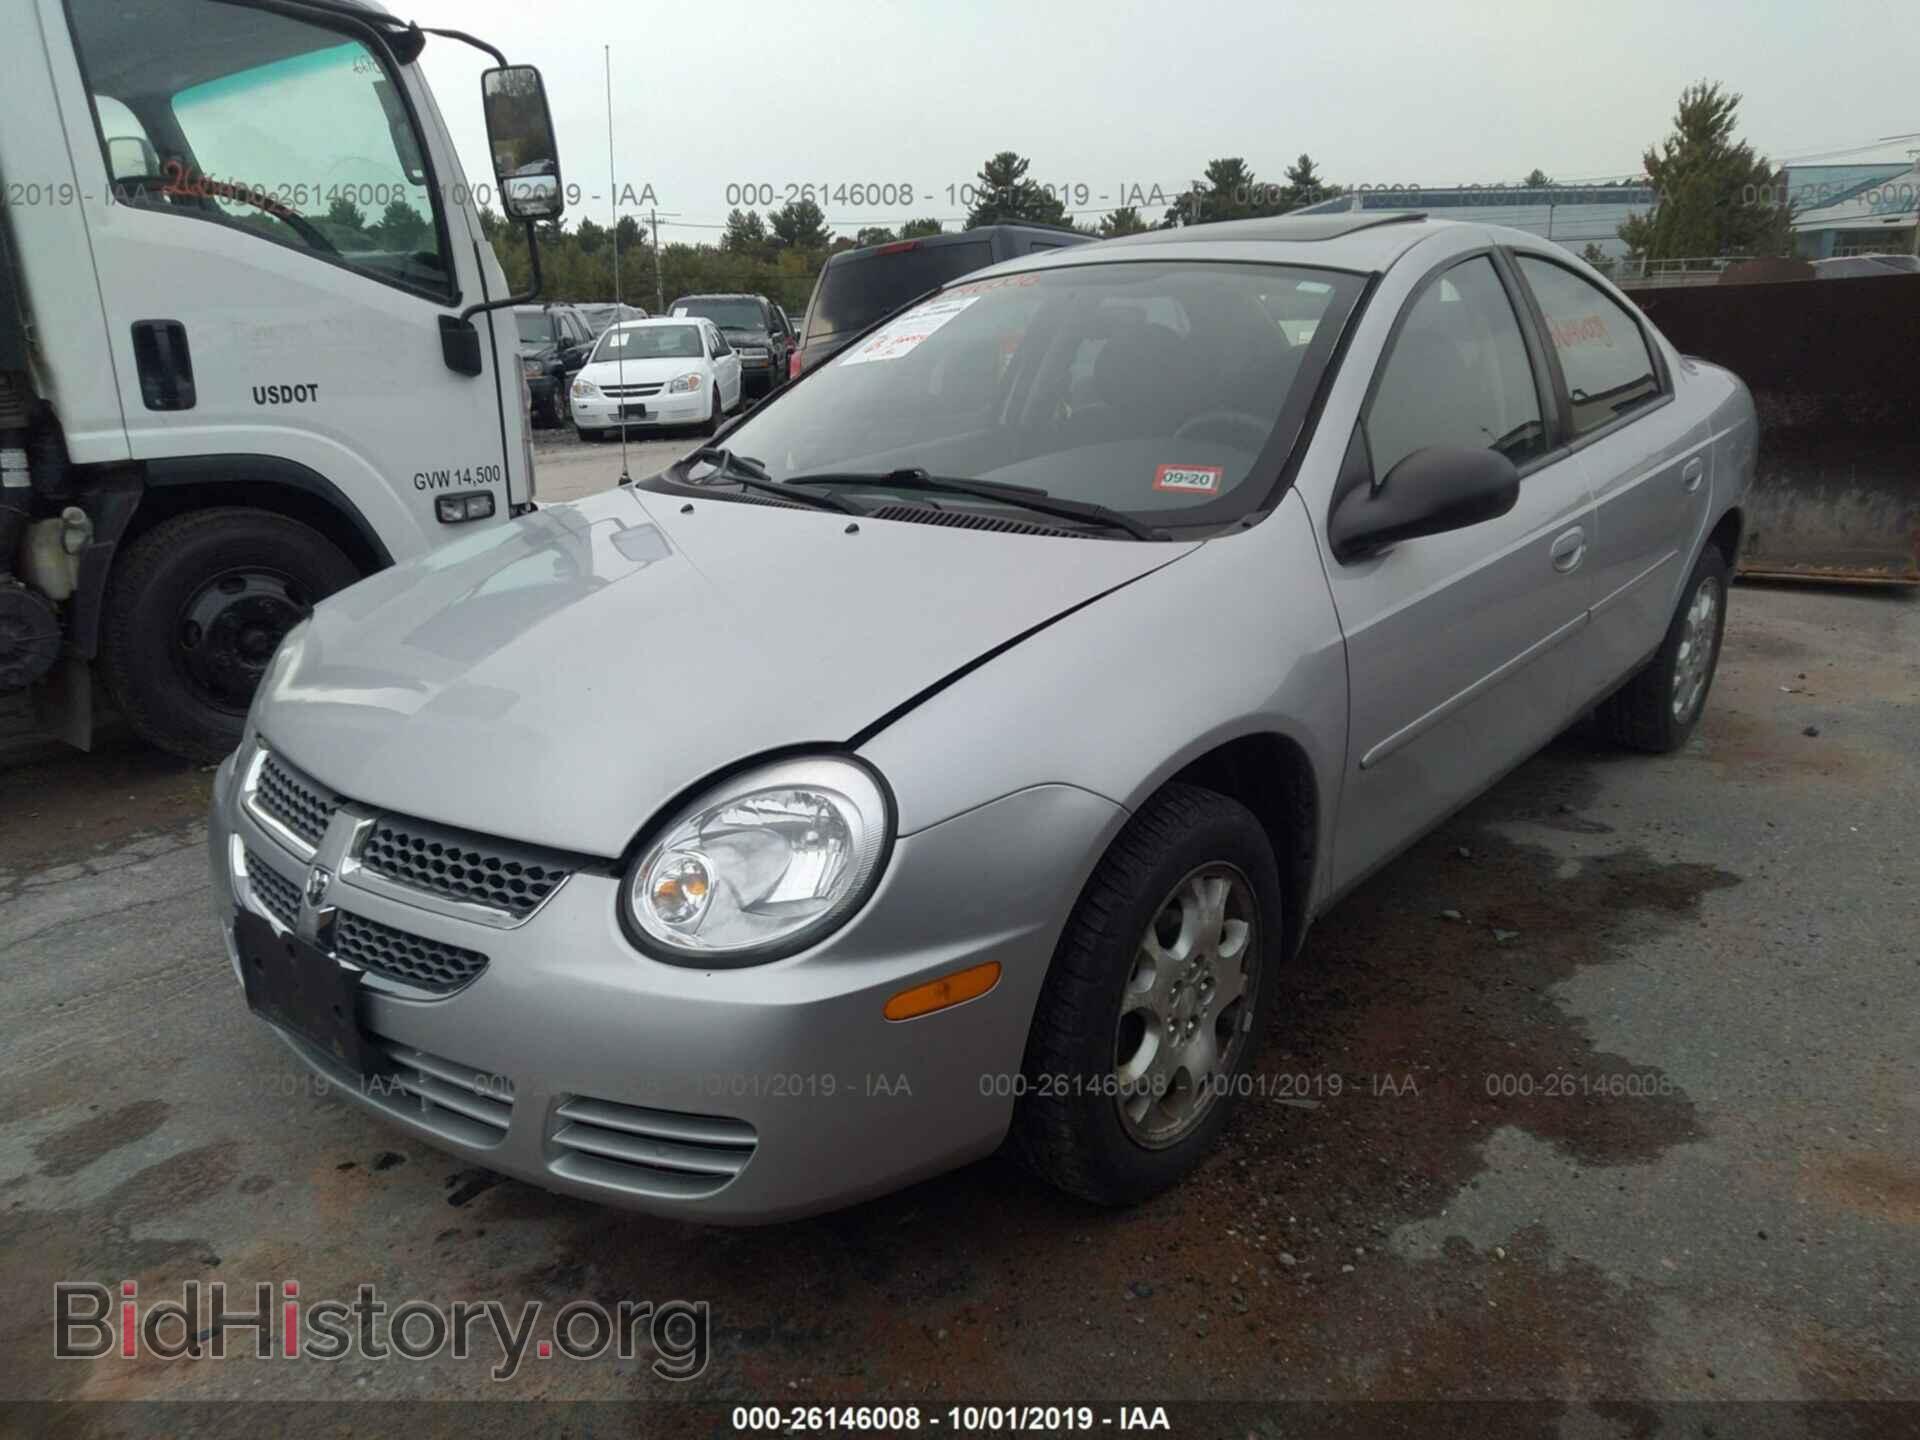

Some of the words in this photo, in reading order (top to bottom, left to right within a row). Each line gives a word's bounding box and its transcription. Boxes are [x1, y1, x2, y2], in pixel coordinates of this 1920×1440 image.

[253, 384, 319, 405] USDOT
[414, 469, 450, 490] GVW
[454, 465, 501, 488] 14,500
[1163, 472, 1210, 485] 09-20
